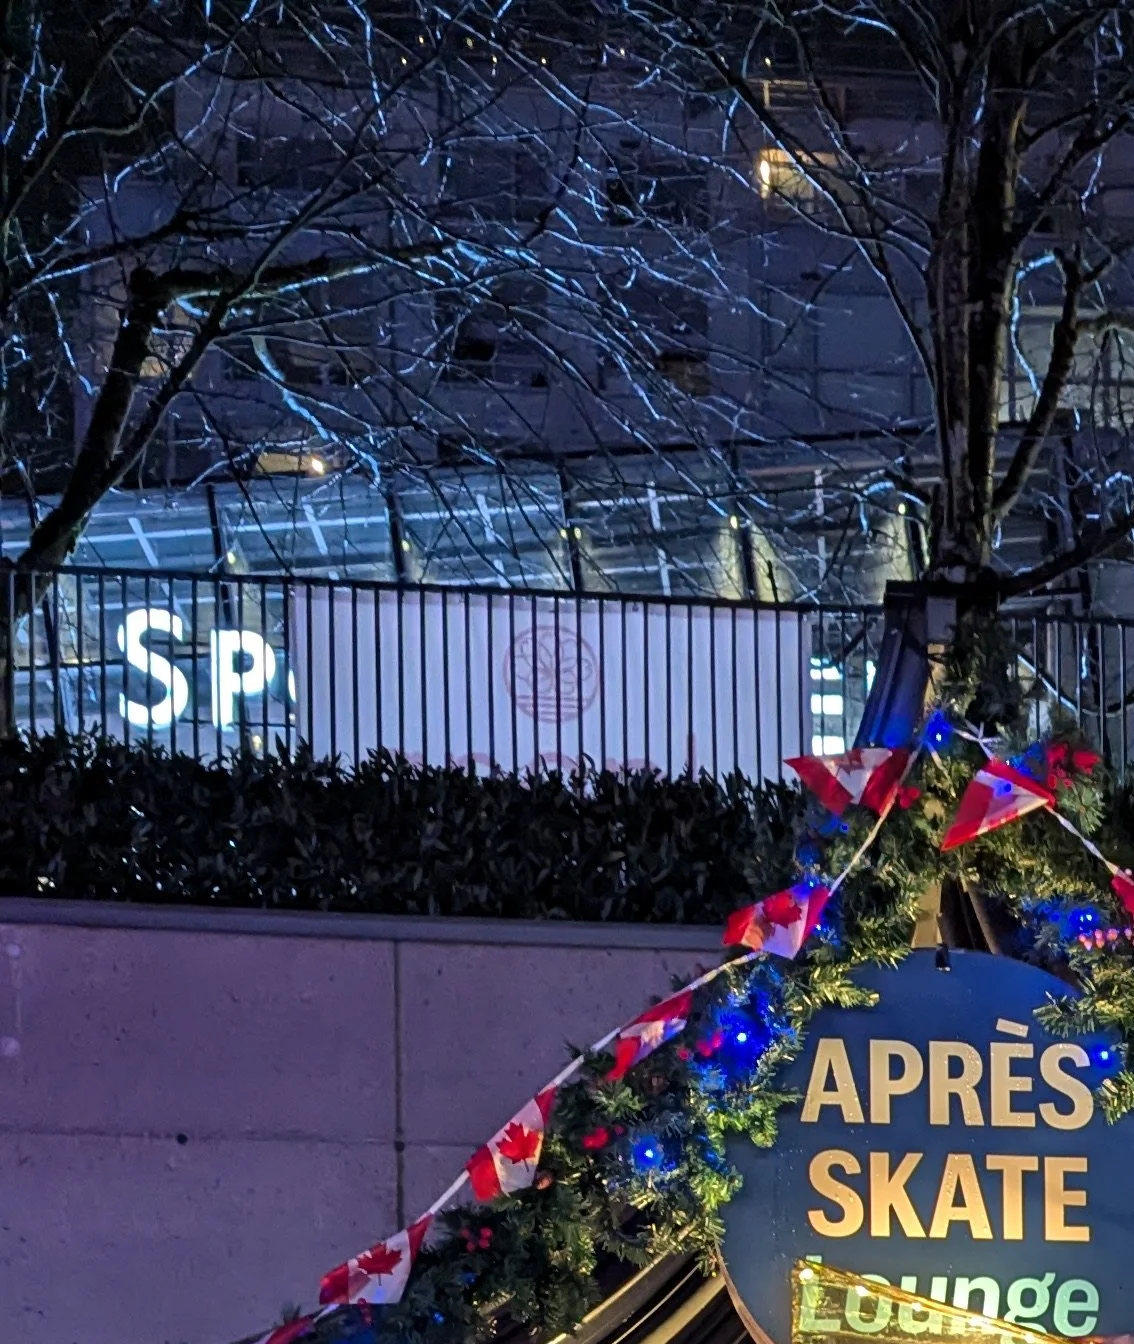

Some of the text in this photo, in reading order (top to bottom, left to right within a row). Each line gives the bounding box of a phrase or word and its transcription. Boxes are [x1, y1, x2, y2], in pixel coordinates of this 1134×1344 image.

[117, 607, 297, 731] SP
[799, 1018, 1092, 1129] APRÈS
[807, 1149, 1091, 1242] SKATE
